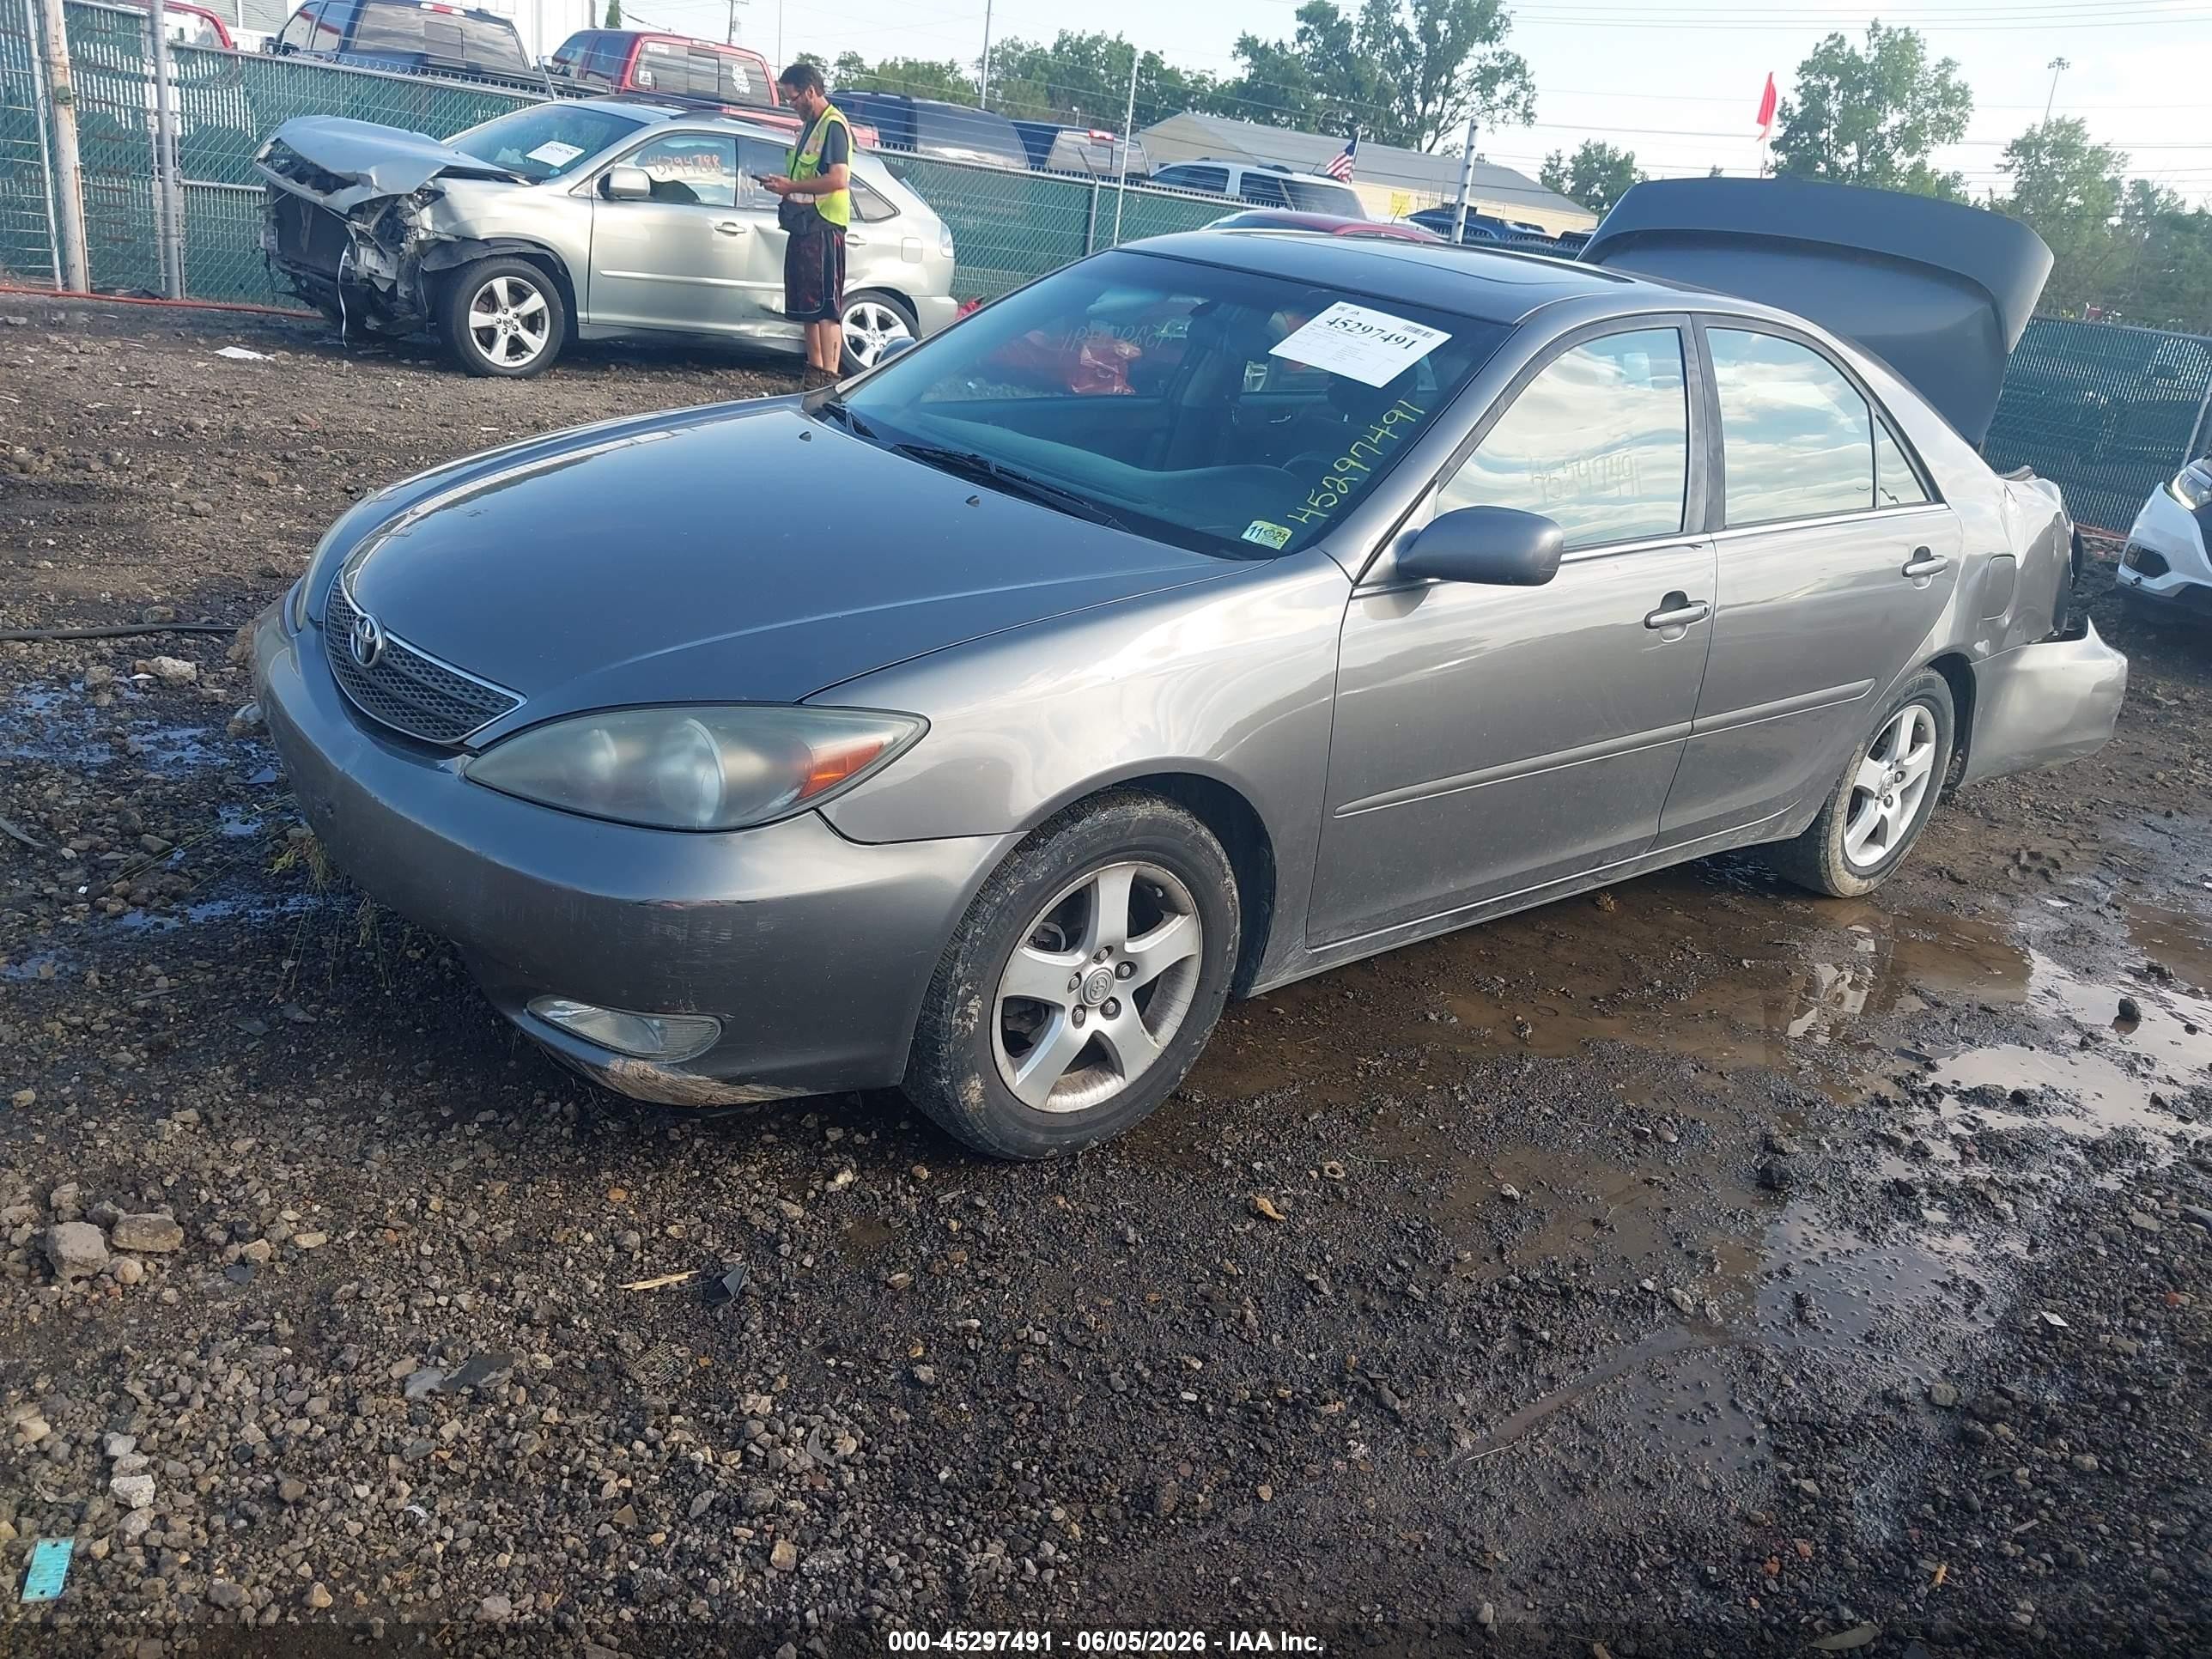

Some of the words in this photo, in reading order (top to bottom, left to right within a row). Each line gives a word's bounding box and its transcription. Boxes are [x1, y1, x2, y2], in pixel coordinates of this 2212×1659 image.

[1326, 317, 1418, 349] 45297491
[1287, 400, 1425, 524] 45297491
[1249, 526, 1263, 539] 11
[1273, 531, 1288, 543] 25
